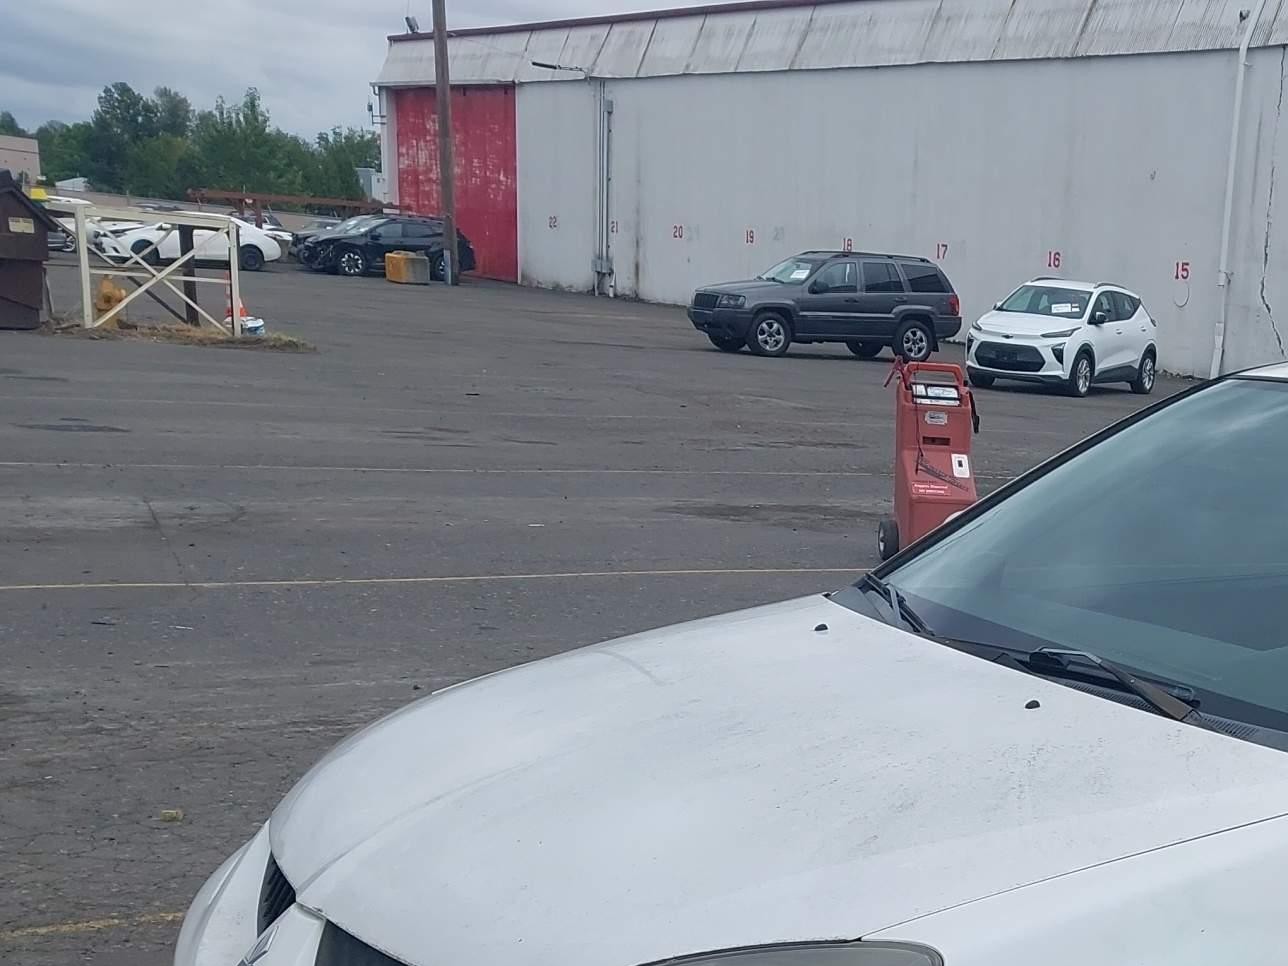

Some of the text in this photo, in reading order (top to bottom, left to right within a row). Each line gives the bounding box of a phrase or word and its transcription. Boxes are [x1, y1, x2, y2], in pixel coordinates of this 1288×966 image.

[673, 225, 683, 239] 20
[745, 229, 754, 243] 19
[842, 238, 852, 252] 18
[937, 243, 947, 259] 17
[1047, 251, 1061, 268] 16
[1174, 262, 1189, 280] 15
